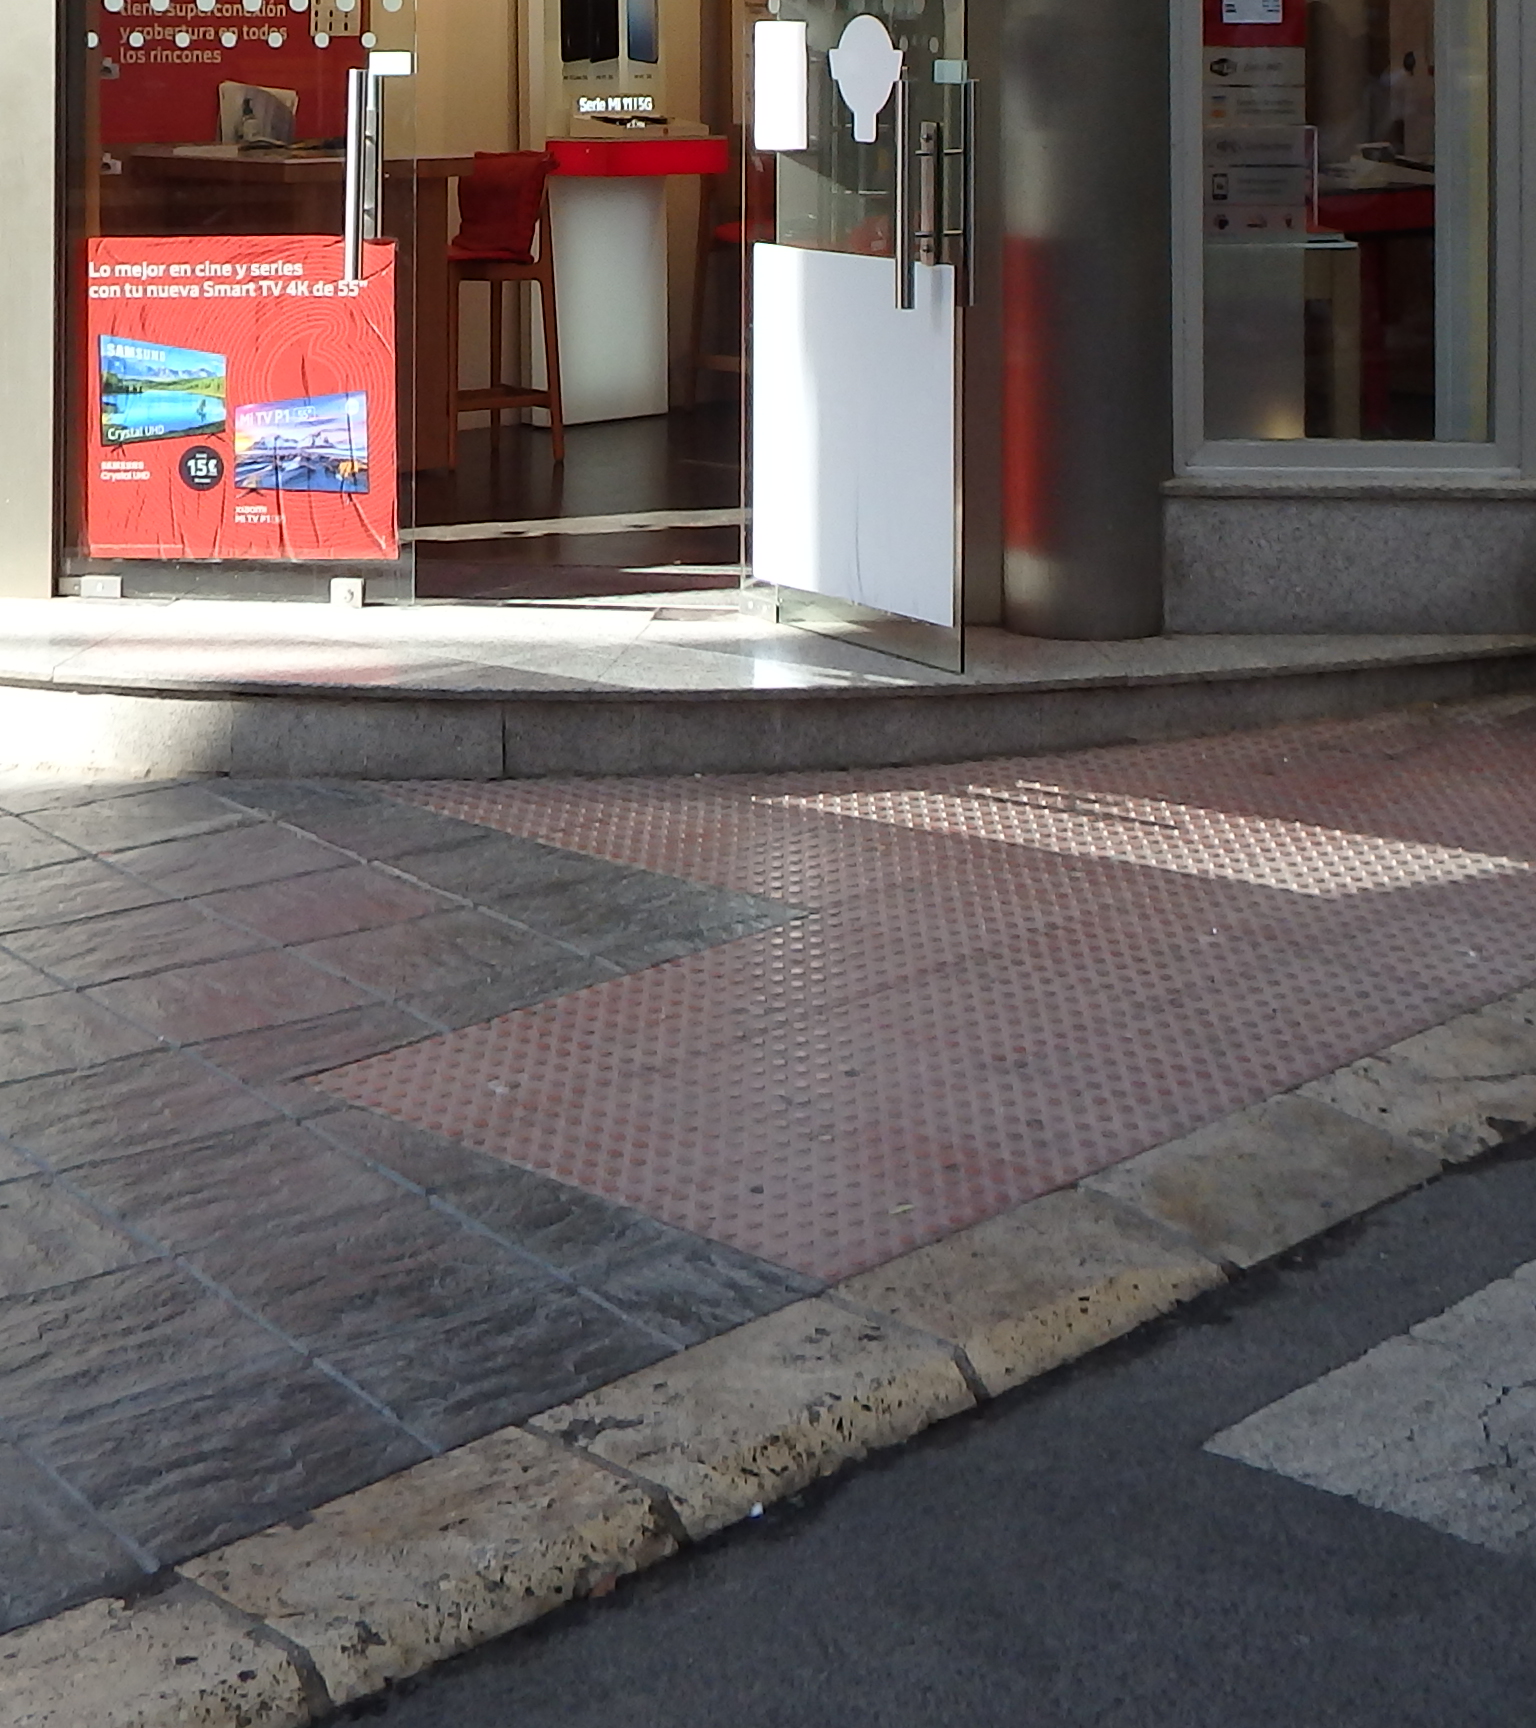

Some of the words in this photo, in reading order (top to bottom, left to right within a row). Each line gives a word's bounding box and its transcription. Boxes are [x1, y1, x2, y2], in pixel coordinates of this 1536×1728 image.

[119, 26, 130, 44] y
[120, 46, 145, 64] los
[150, 46, 222, 64] rincones
[579, 97, 607, 112] Serie
[88, 261, 111, 278] Lo
[114, 261, 166, 280] mejor
[169, 263, 192, 277] en
[195, 260, 232, 277] cine
[236, 263, 247, 279] y
[250, 260, 303, 276] series
[88, 285, 121, 298] con
[124, 283, 143, 298] tu
[146, 284, 200, 298] nueva
[203, 280, 256, 297] Smart
[259, 281, 283, 297] TV
[286, 280, 309, 296] 4K
[312, 280, 334, 296] de
[106, 343, 166, 362] SAMSUNG
[255, 410, 273, 426] TV
[275, 409, 290, 423] P1
[107, 426, 144, 441] Crystal
[145, 424, 165, 436] UHD
